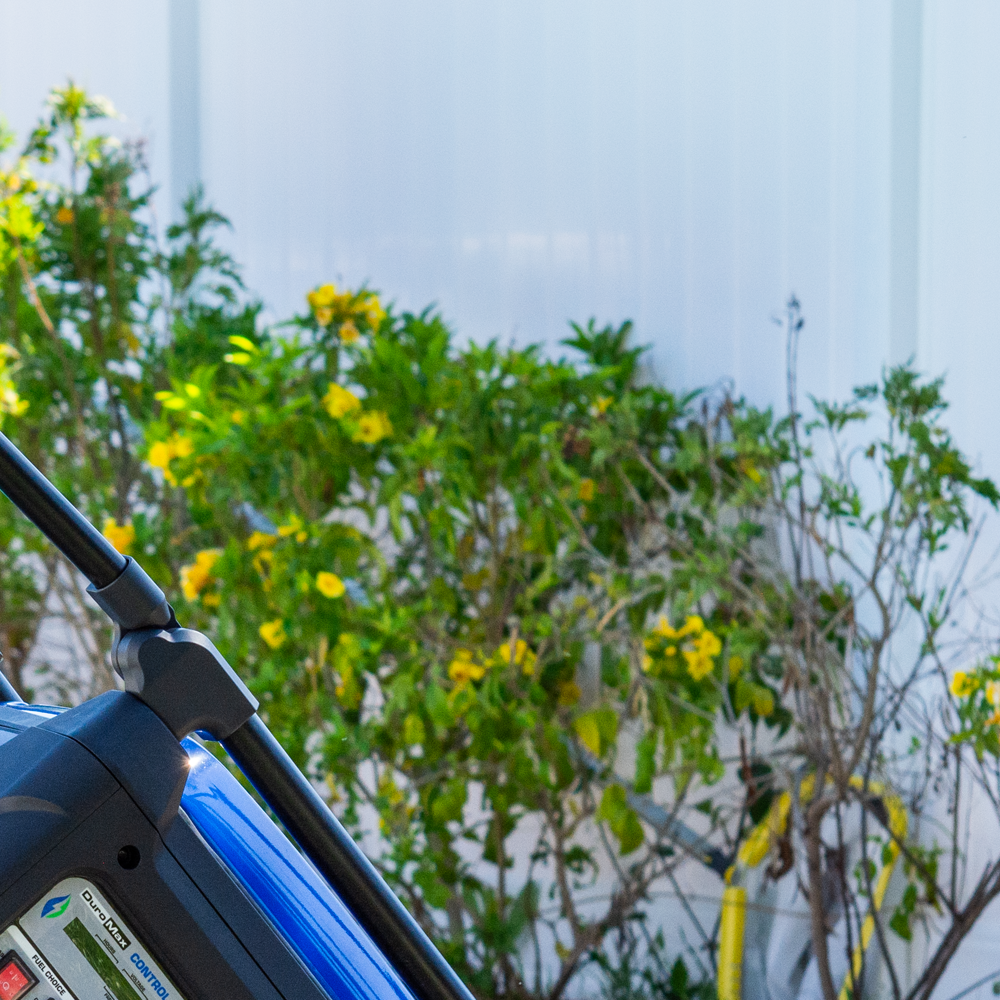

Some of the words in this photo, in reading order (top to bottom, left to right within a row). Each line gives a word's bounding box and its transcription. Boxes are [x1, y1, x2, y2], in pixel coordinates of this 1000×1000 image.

[102, 938, 115, 954] HOURS
[31, 954, 47, 972] FUEL
[44, 970, 66, 996] CHOICE
[129, 973, 145, 992] VOLTAGE
